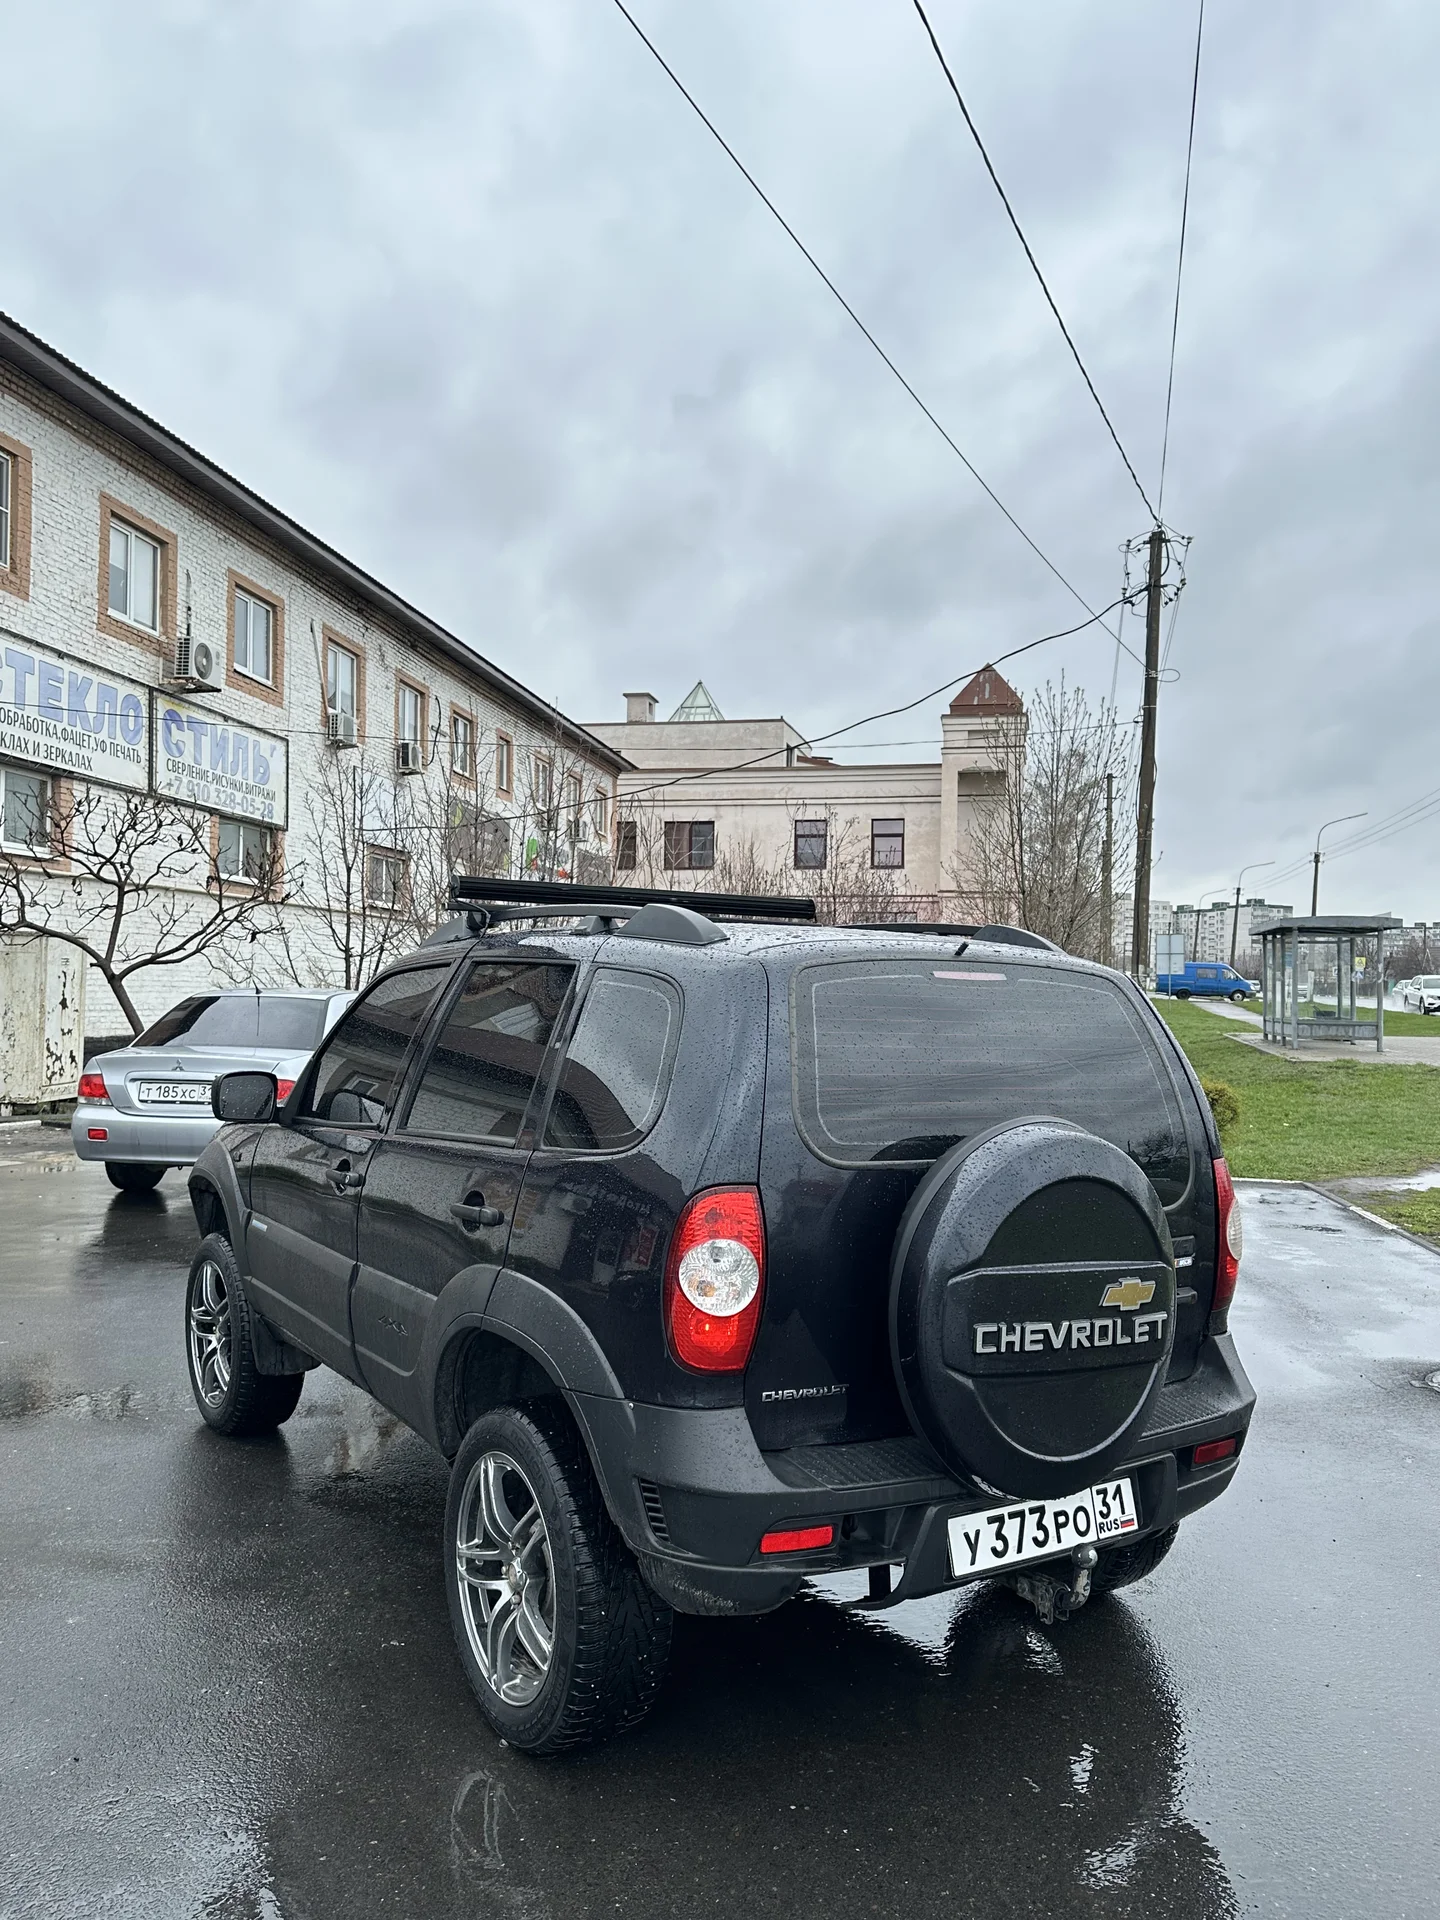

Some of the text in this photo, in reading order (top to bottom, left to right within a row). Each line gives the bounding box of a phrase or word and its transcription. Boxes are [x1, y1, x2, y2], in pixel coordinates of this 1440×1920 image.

[0, 647, 144, 746] ТЕКЛО
[32, 740, 41, 757] И
[43, 743, 93, 772] ЗЕРКАЛАХ
[109, 741, 142, 764] ПЕЧАТЬ
[166, 775, 274, 820] +7 910 328-05-28
[973, 1312, 1168, 1354] CHEVROLET
[761, 1384, 850, 1402] CHEVROLET
[1096, 1483, 1126, 1520] 31
[1099, 1519, 1120, 1535] RUS
